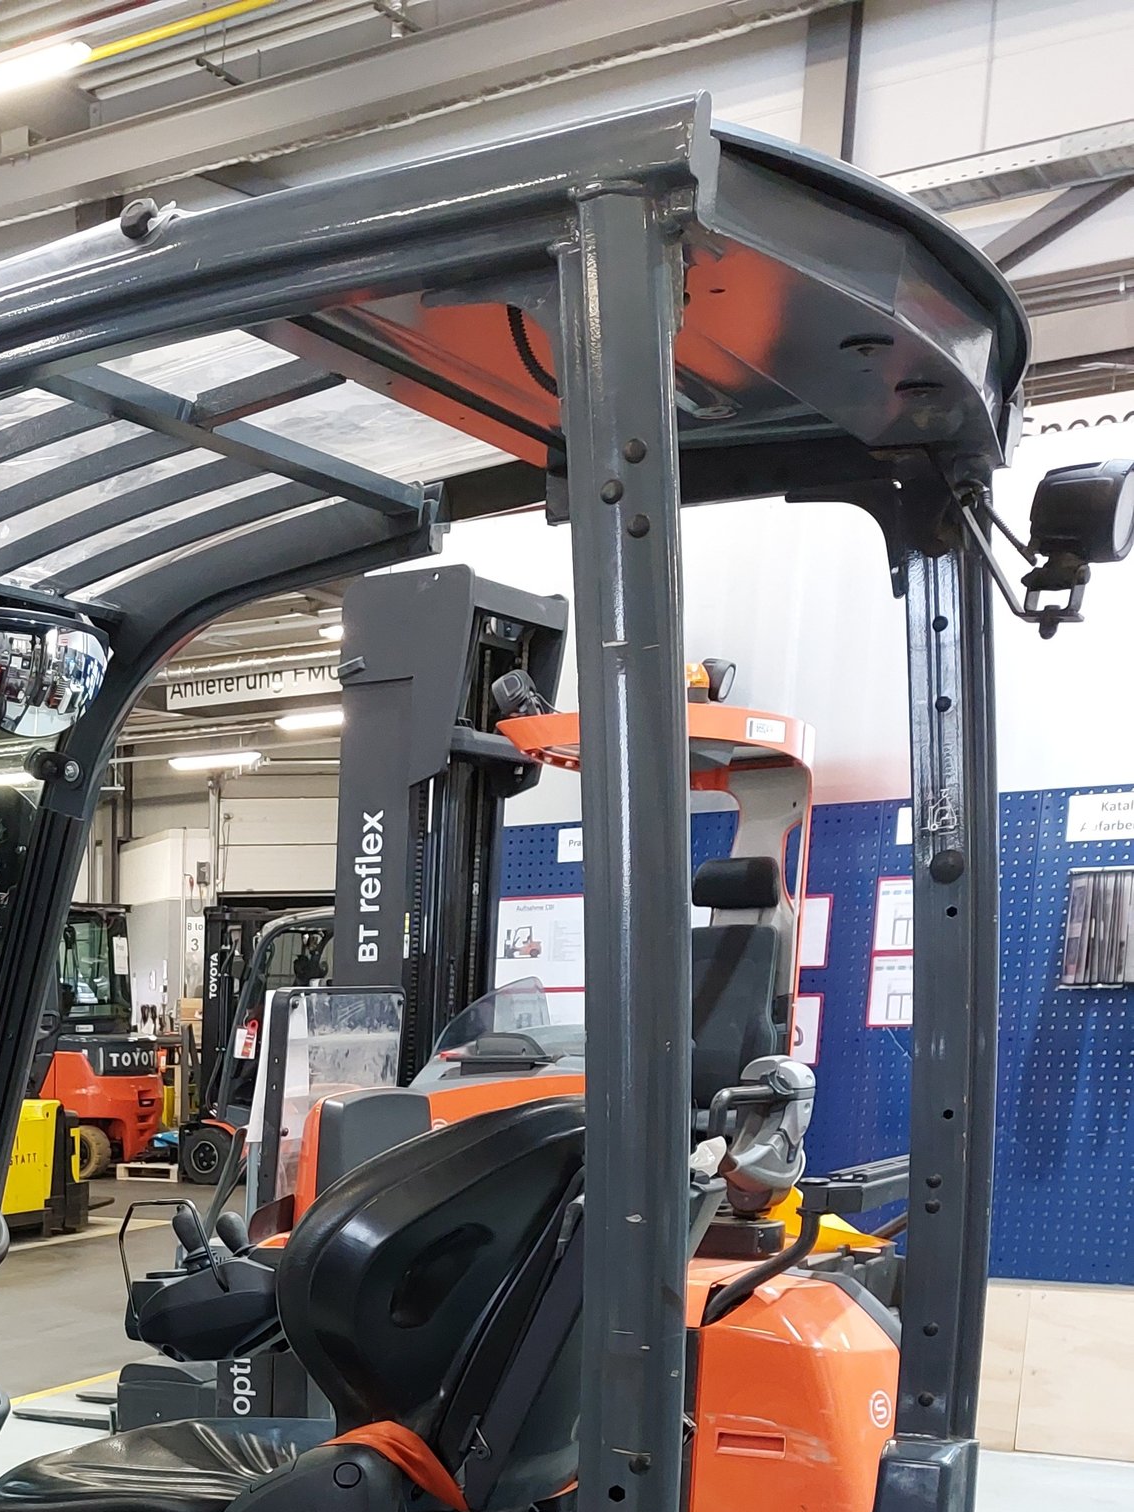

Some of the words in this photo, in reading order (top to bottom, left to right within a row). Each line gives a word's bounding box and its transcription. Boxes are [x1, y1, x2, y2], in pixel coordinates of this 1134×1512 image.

[354, 809, 384, 913] reflex
[357, 923, 380, 963] BT
[209, 952, 219, 1000] TOYOTA
